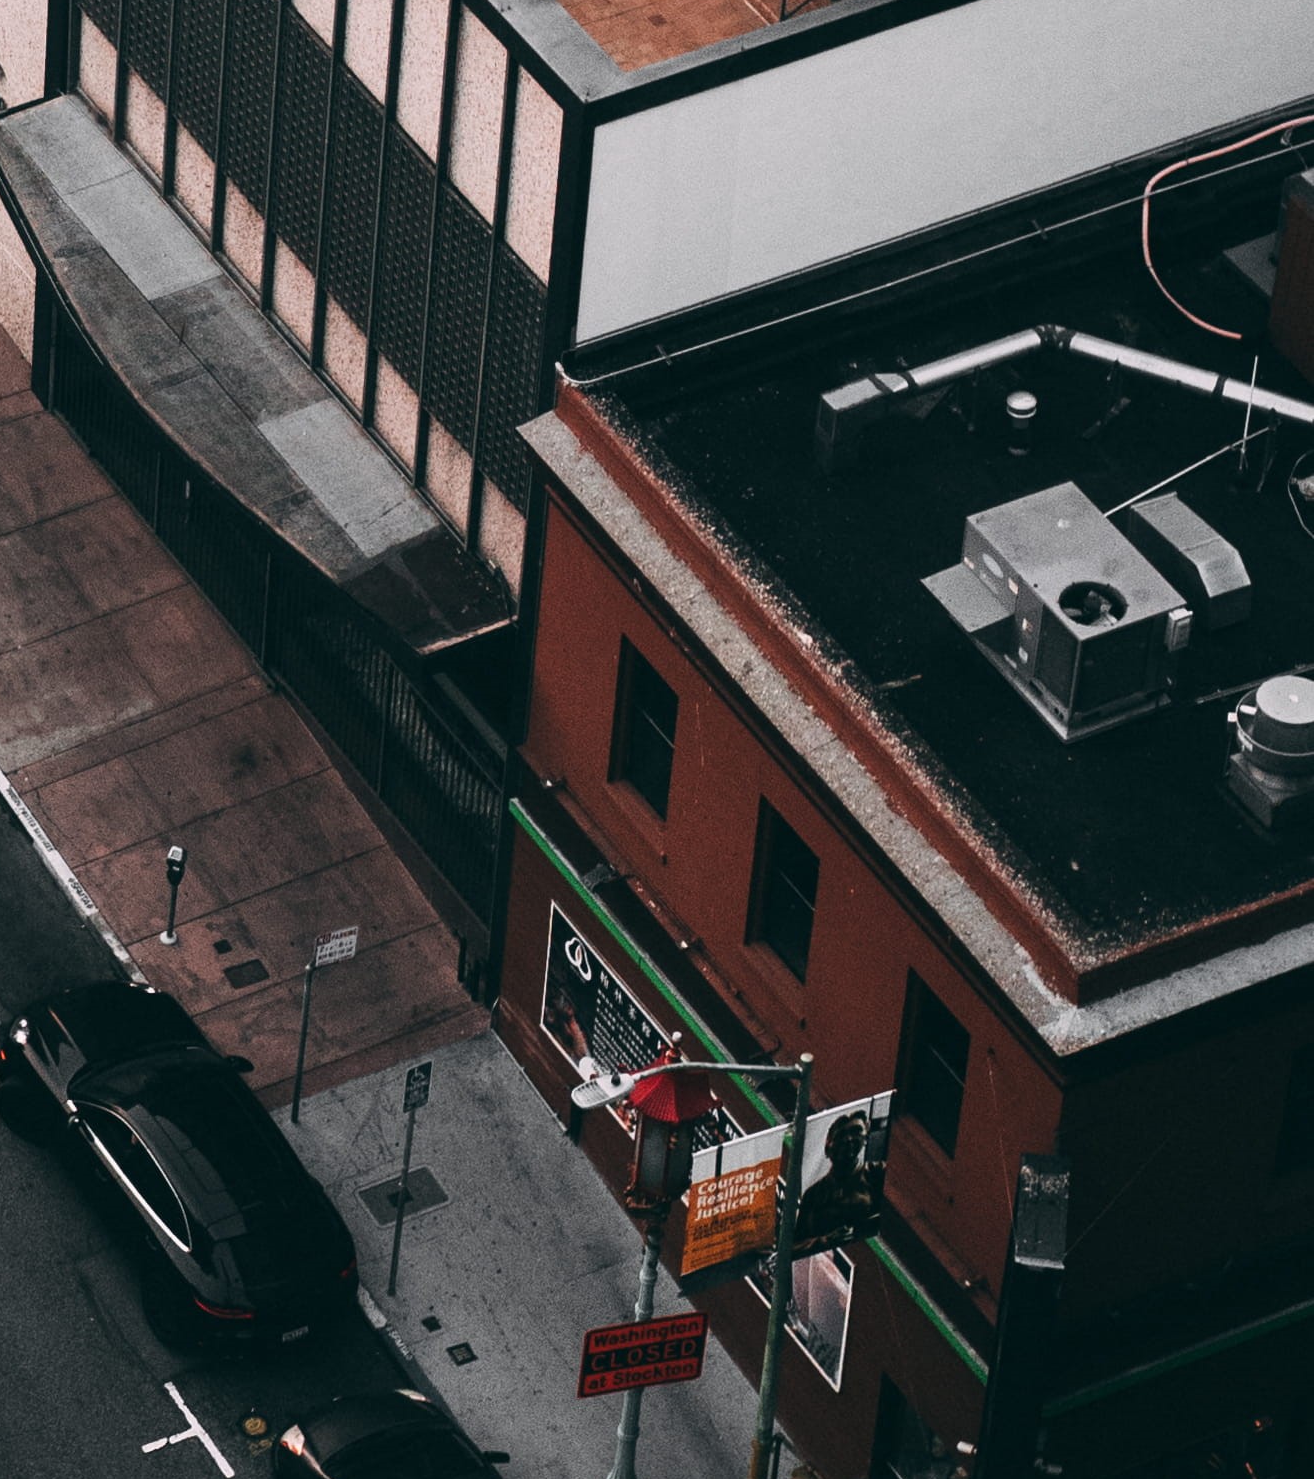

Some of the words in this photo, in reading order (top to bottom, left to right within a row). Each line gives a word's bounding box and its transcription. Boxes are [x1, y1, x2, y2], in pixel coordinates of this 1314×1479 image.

[332, 928, 358, 941] PARKING
[697, 1175, 775, 1208] Resilience
[698, 1169, 763, 1195] Courage
[695, 1193, 755, 1221] Justice!
[594, 1321, 700, 1347] Washington
[591, 1339, 697, 1371] CLOSED
[588, 1376, 607, 1389] at
[613, 1362, 694, 1386] Stockton
